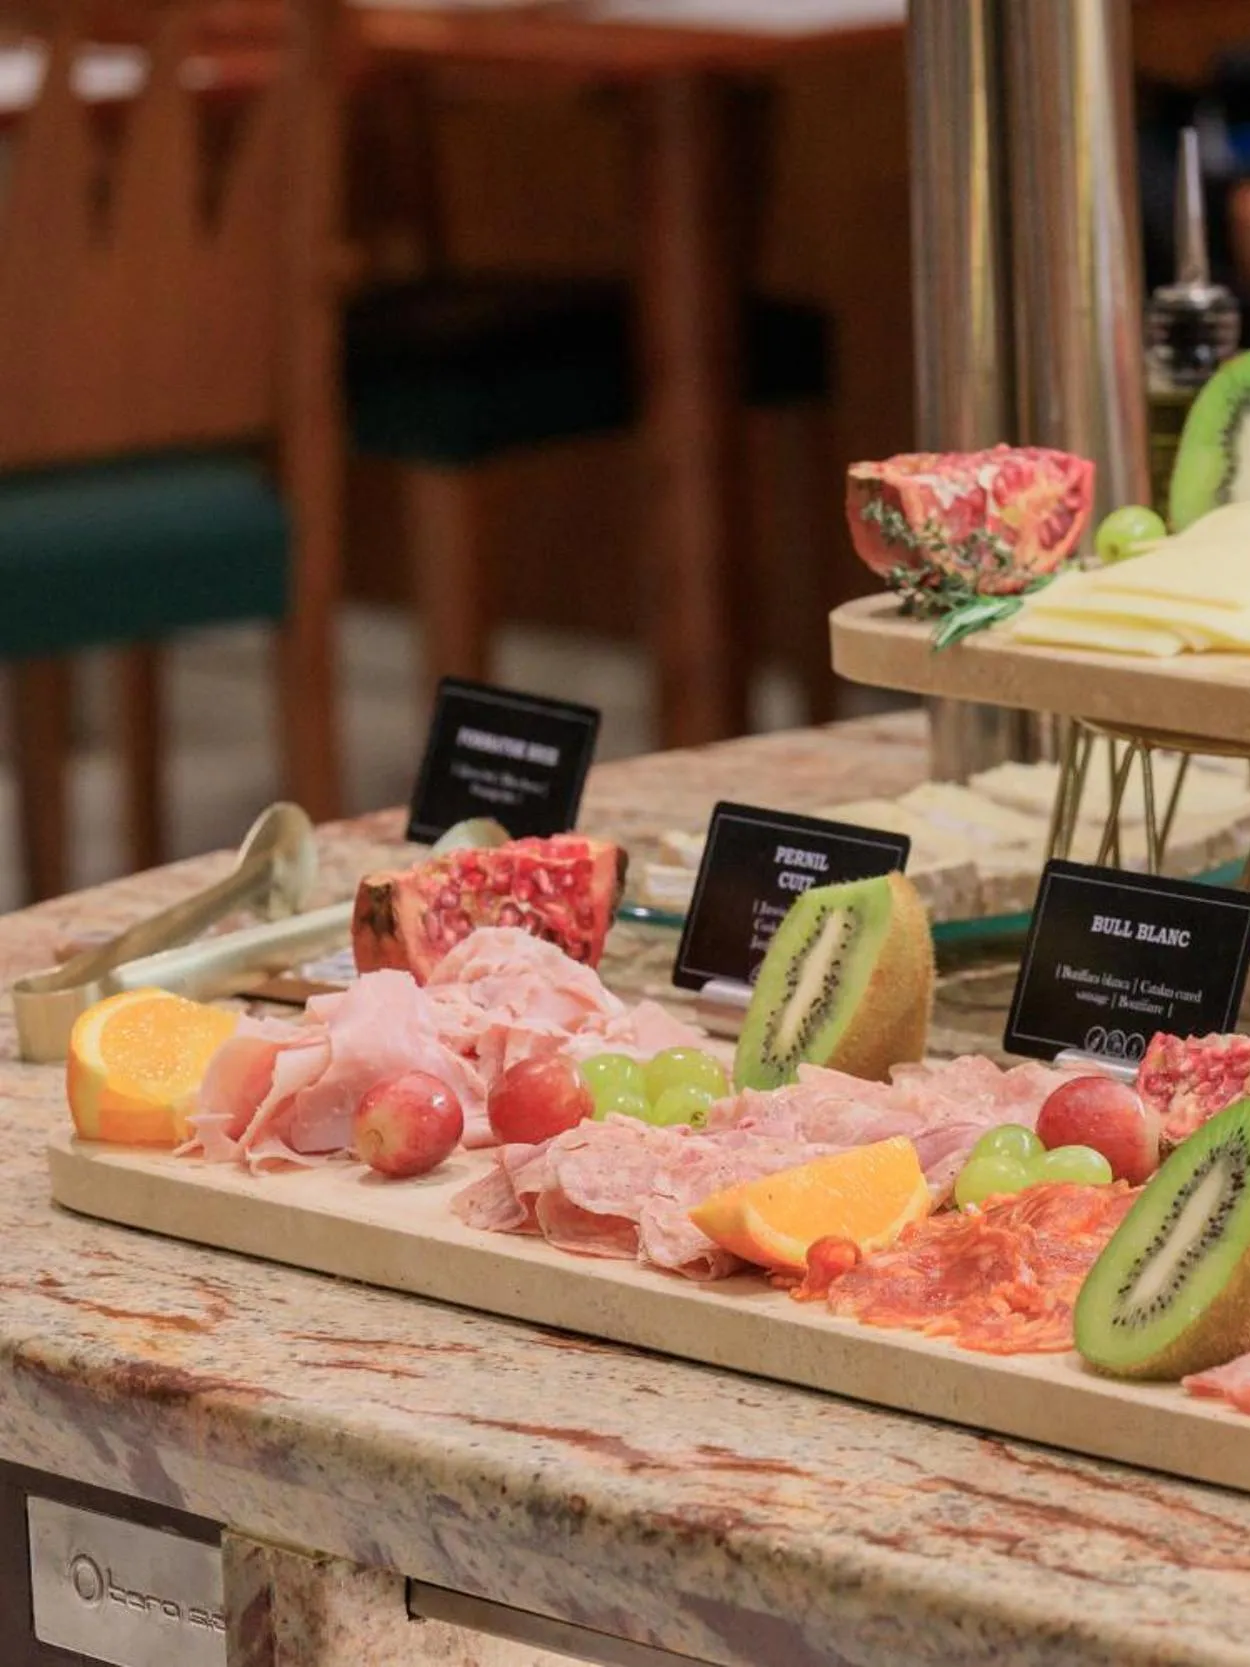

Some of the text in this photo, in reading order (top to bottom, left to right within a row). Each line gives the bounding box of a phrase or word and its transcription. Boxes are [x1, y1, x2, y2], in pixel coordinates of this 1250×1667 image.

[774, 846, 829, 872] PERNIL
[1091, 915, 1191, 948] BULL BLANC
